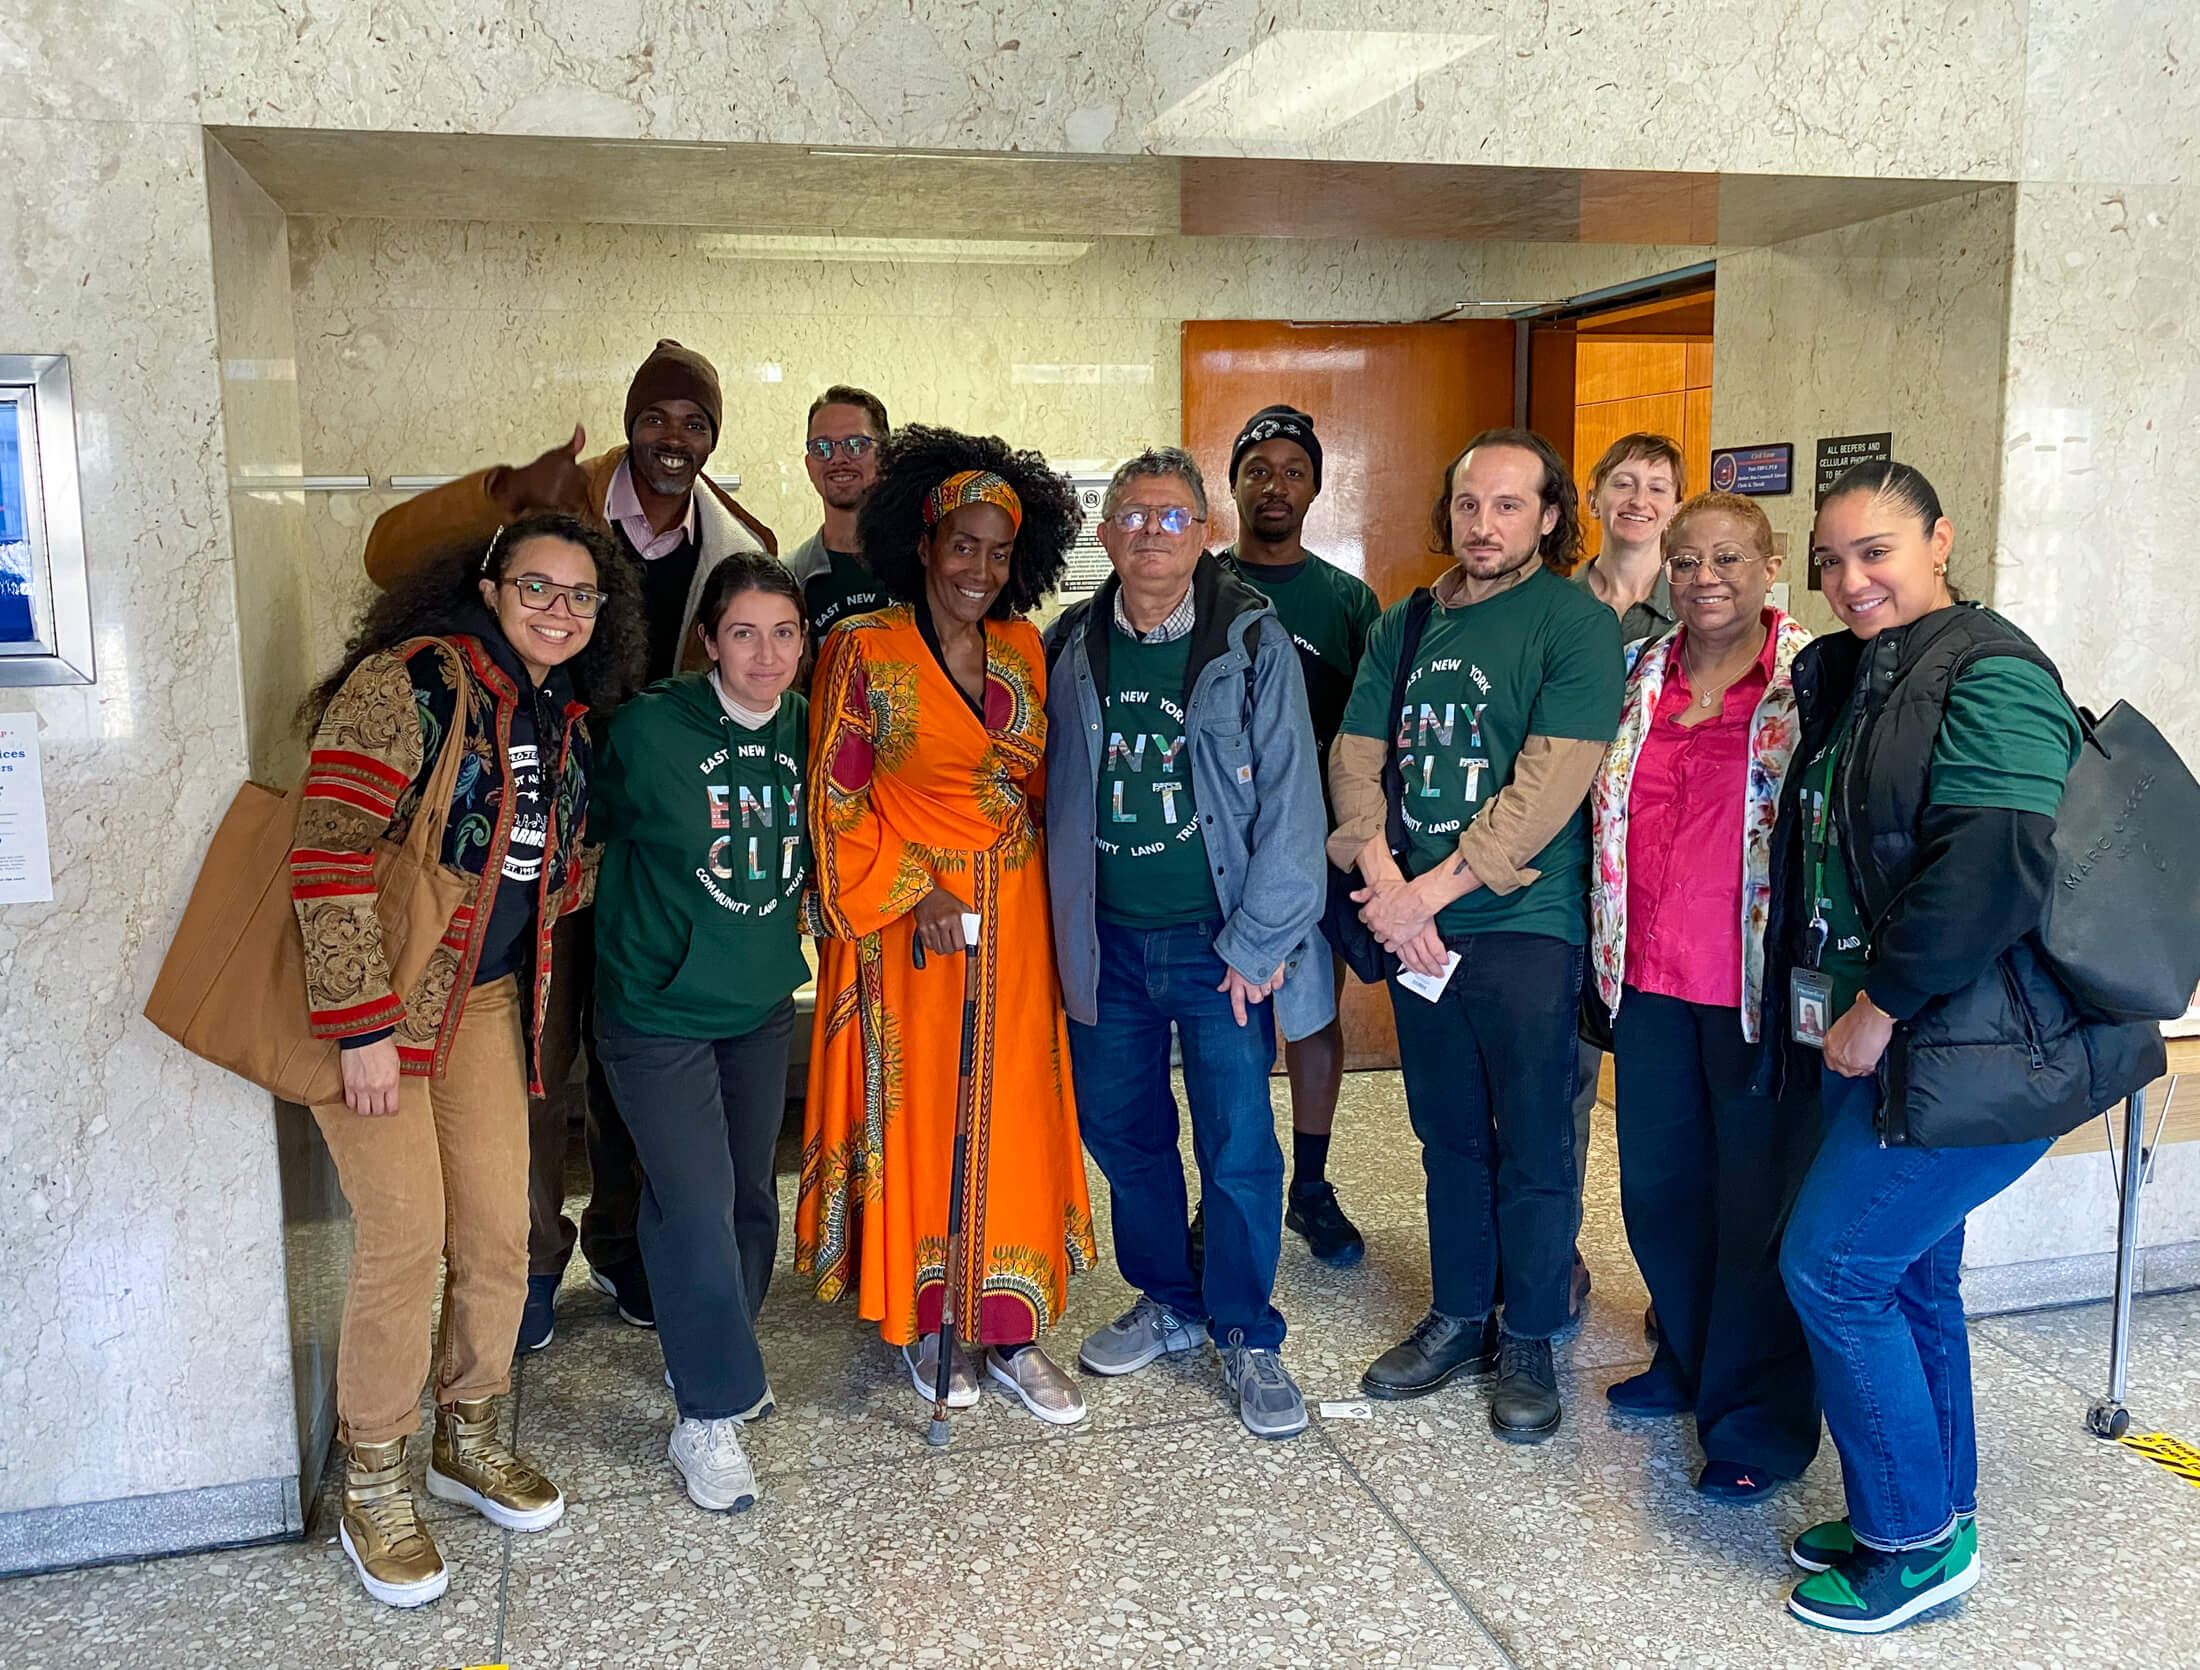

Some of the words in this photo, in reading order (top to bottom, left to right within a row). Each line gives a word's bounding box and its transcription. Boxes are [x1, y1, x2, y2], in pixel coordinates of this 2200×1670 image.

[1820, 457, 1849, 467] CELLULAR
[1827, 446, 1838, 455] ALL
[1840, 443, 1866, 454] BEEPERS
[1868, 442, 1880, 451] AND
[1825, 471, 1833, 480] TO
[815, 602, 840, 628] EAST
[846, 593, 876, 606] NEW
[1431, 658, 1462, 673] NEW
[1468, 664, 1492, 696] YORK
[1120, 690, 1149, 704] NEW
[1159, 698, 1184, 725] YOR
[700, 749, 730, 775] EAST
[738, 745, 765, 758] NEW
[707, 783, 801, 829] ENY
[510, 826, 546, 848] ARMS
[1131, 842, 1165, 857] LAND
[1175, 811, 1200, 842] TRUS
[1428, 819, 1460, 834] LAND
[709, 835, 800, 880] CLT
[2064, 836, 2112, 890] MARC
[695, 867, 750, 915] COMMUNITY
[758, 898, 777, 917] LAND
[785, 866, 805, 897] TRUST
